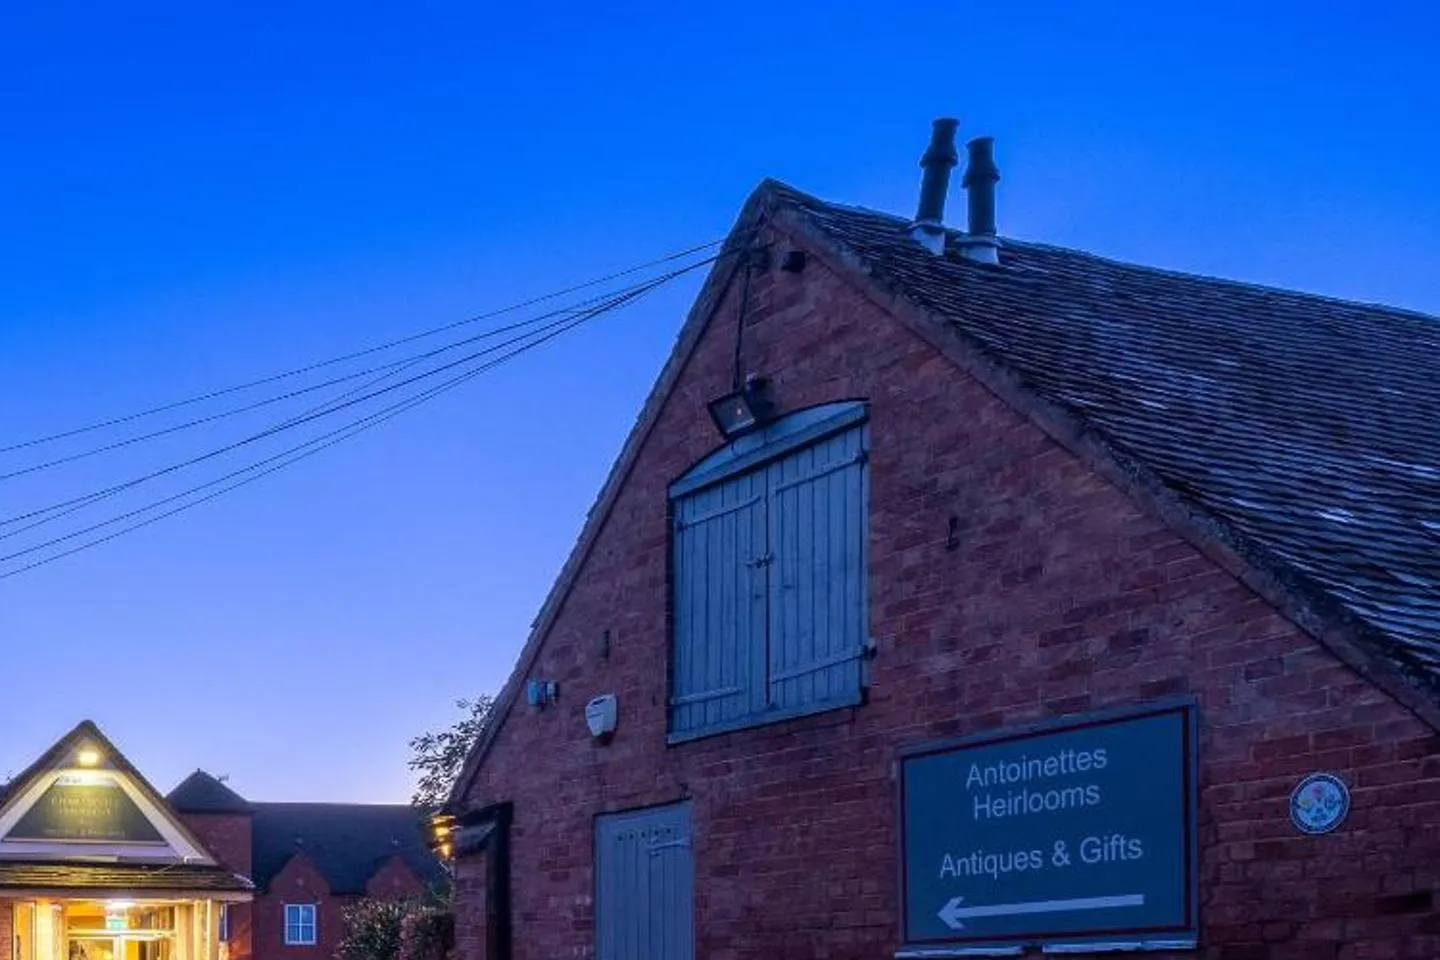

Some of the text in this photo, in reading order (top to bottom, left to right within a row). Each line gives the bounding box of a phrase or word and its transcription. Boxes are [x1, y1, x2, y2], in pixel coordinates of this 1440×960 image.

[965, 748, 1108, 790] Antoinettes
[973, 784, 1101, 821] Heirlooms
[939, 834, 1144, 880] Antiques & Gifts
